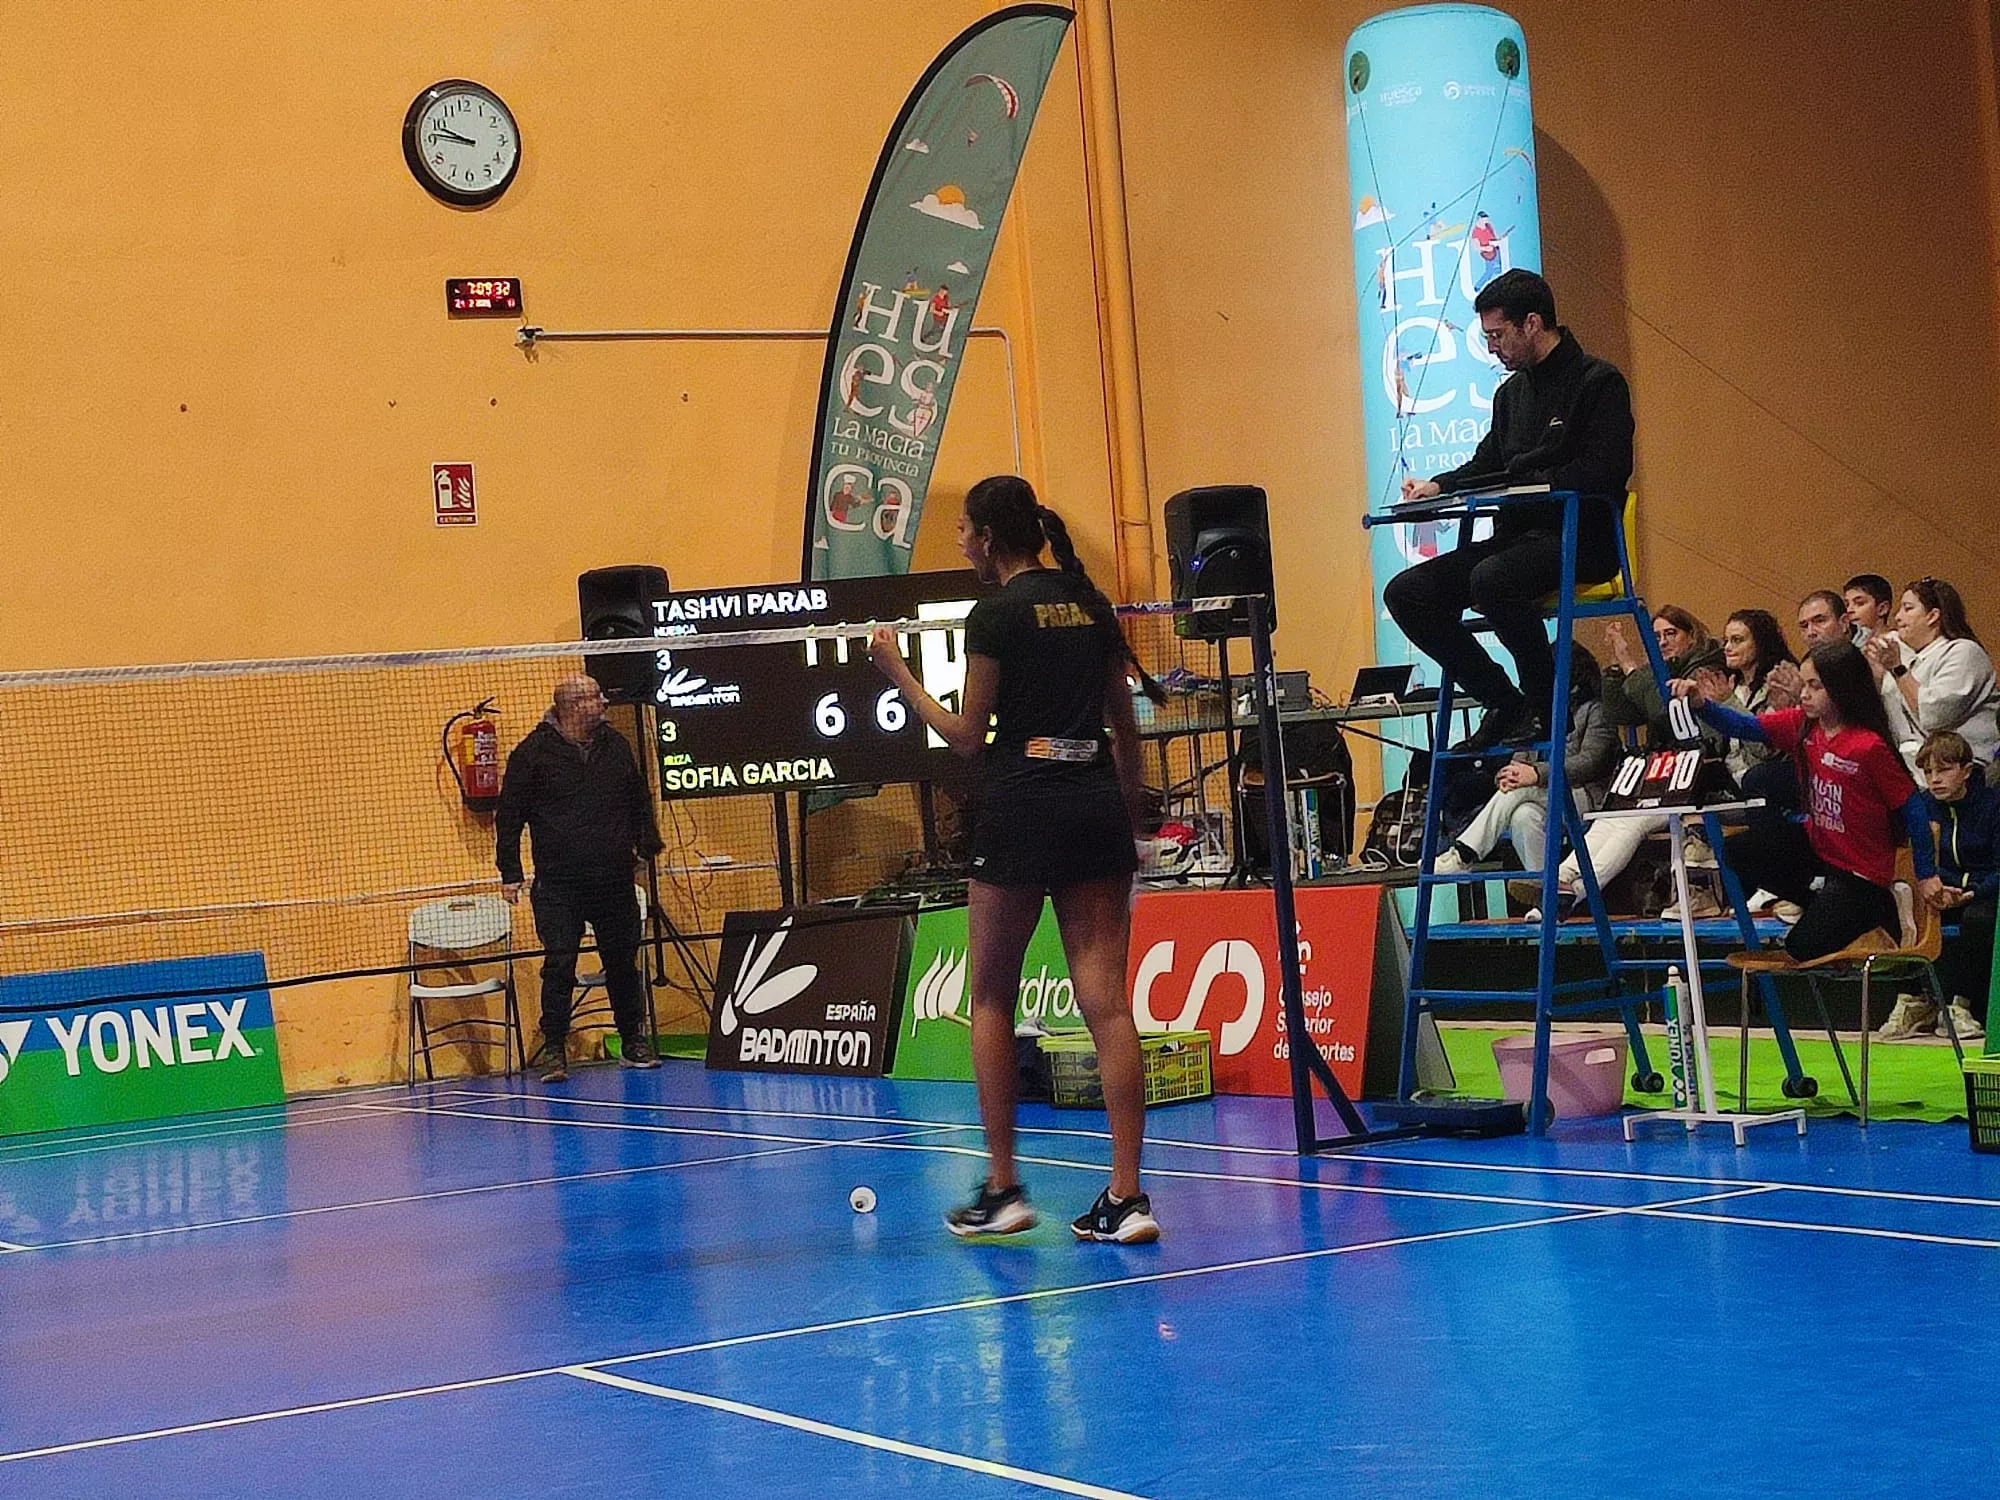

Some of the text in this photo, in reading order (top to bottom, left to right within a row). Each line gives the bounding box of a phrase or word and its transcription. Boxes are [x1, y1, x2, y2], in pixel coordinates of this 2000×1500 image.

[443, 104, 455, 118] 11
[457, 99, 471, 113] 12
[477, 104, 483, 117] 1
[489, 115, 498, 128] 2
[427, 133, 438, 147] 9
[498, 133, 508, 147] 3
[431, 152, 444, 165] 8
[492, 151, 502, 164] 4
[449, 164, 458, 178] 7
[465, 169, 474, 181] 6
[482, 164, 492, 178] 5
[652, 589, 828, 622] TASHVI PARAB
[656, 650, 671, 671] 3
[815, 687, 907, 736] 6 6
[661, 721, 677, 742] 3
[665, 758, 835, 791] SOFIA GARCIA
[1610, 755, 1646, 796] 10
[1668, 750, 1700, 792] 10
[825, 1000, 876, 1021] ESPAÑA
[45, 998, 256, 1076] YONEX
[739, 1028, 870, 1067] BADMINTON
